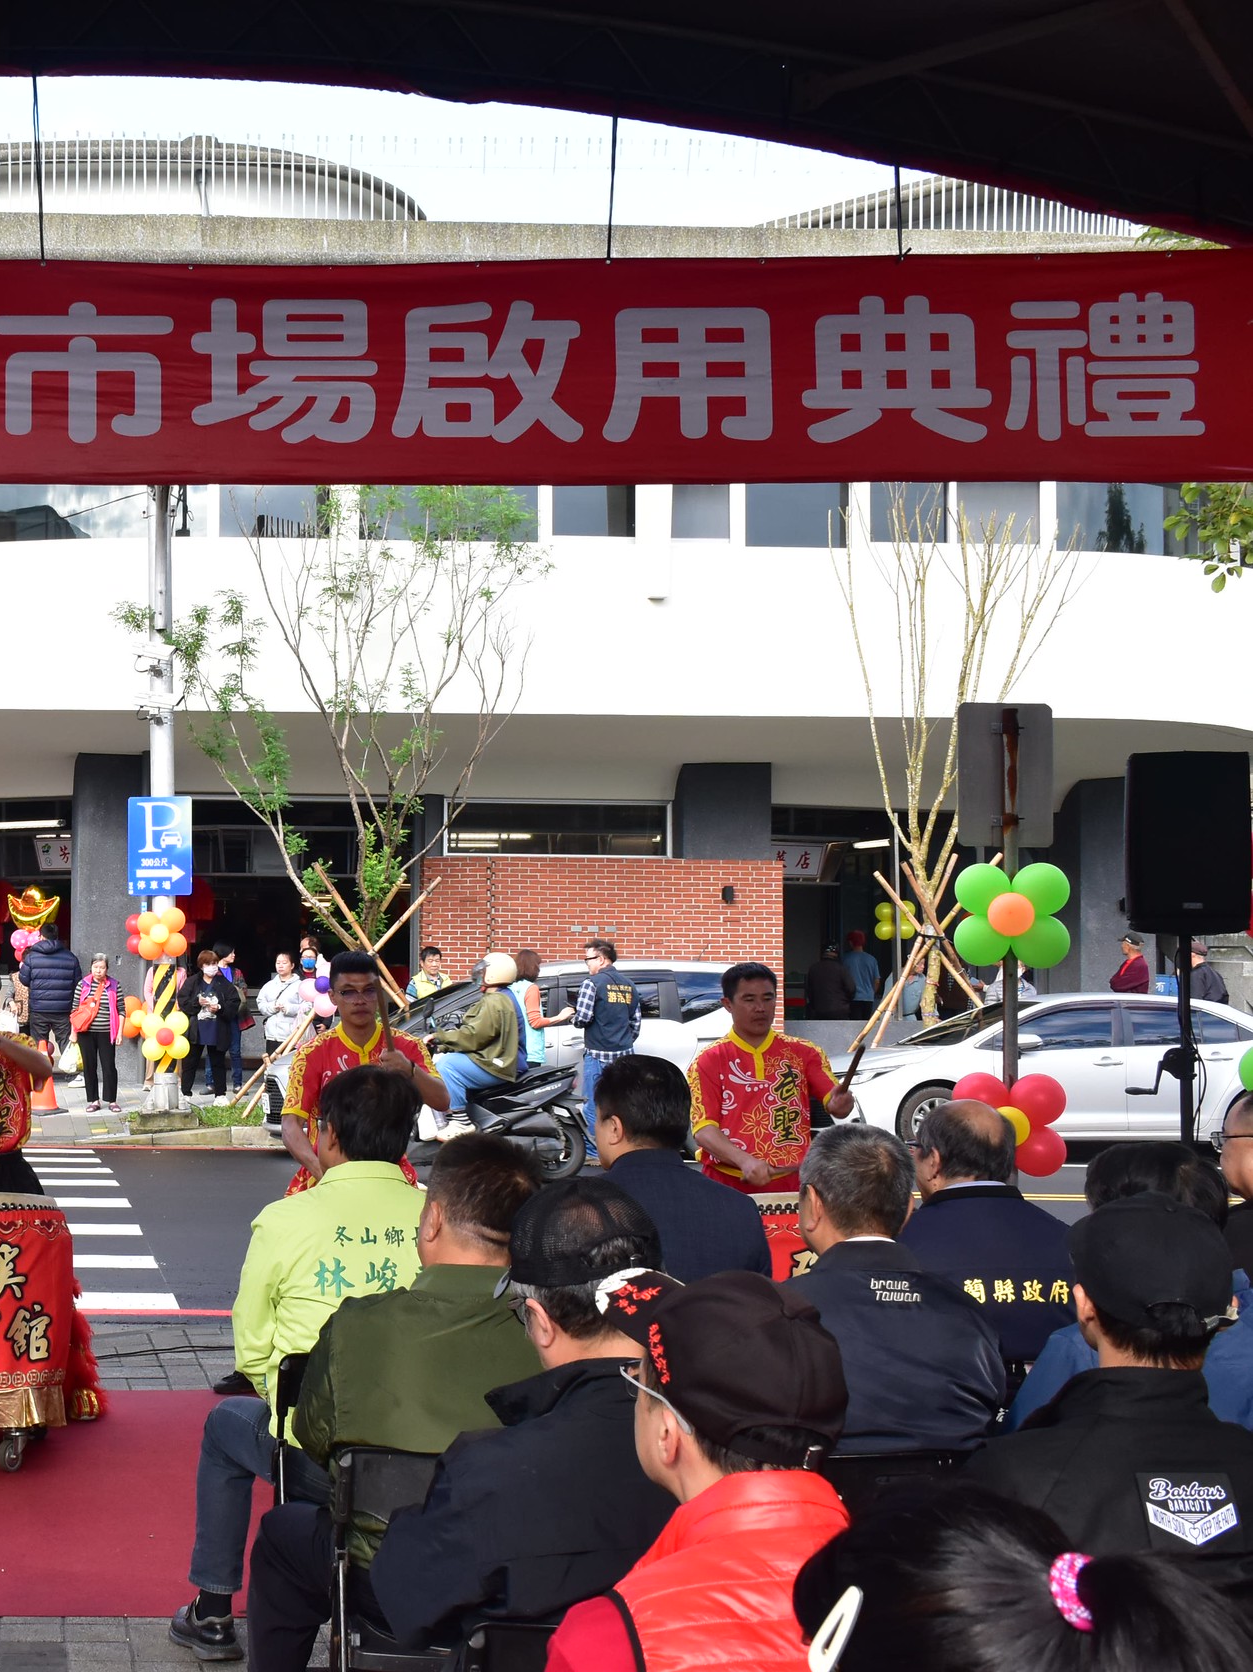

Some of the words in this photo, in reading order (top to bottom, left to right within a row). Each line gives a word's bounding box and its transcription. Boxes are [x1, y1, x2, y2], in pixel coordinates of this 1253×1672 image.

[137, 802, 181, 853] P
[137, 880, 171, 890] 停車場
[772, 1063, 802, 1143] 武聖
[314, 1257, 424, 1298] 林峻
[1149, 1478, 1226, 1500] Barbour
[1168, 1499, 1212, 1512] BARACUTA
